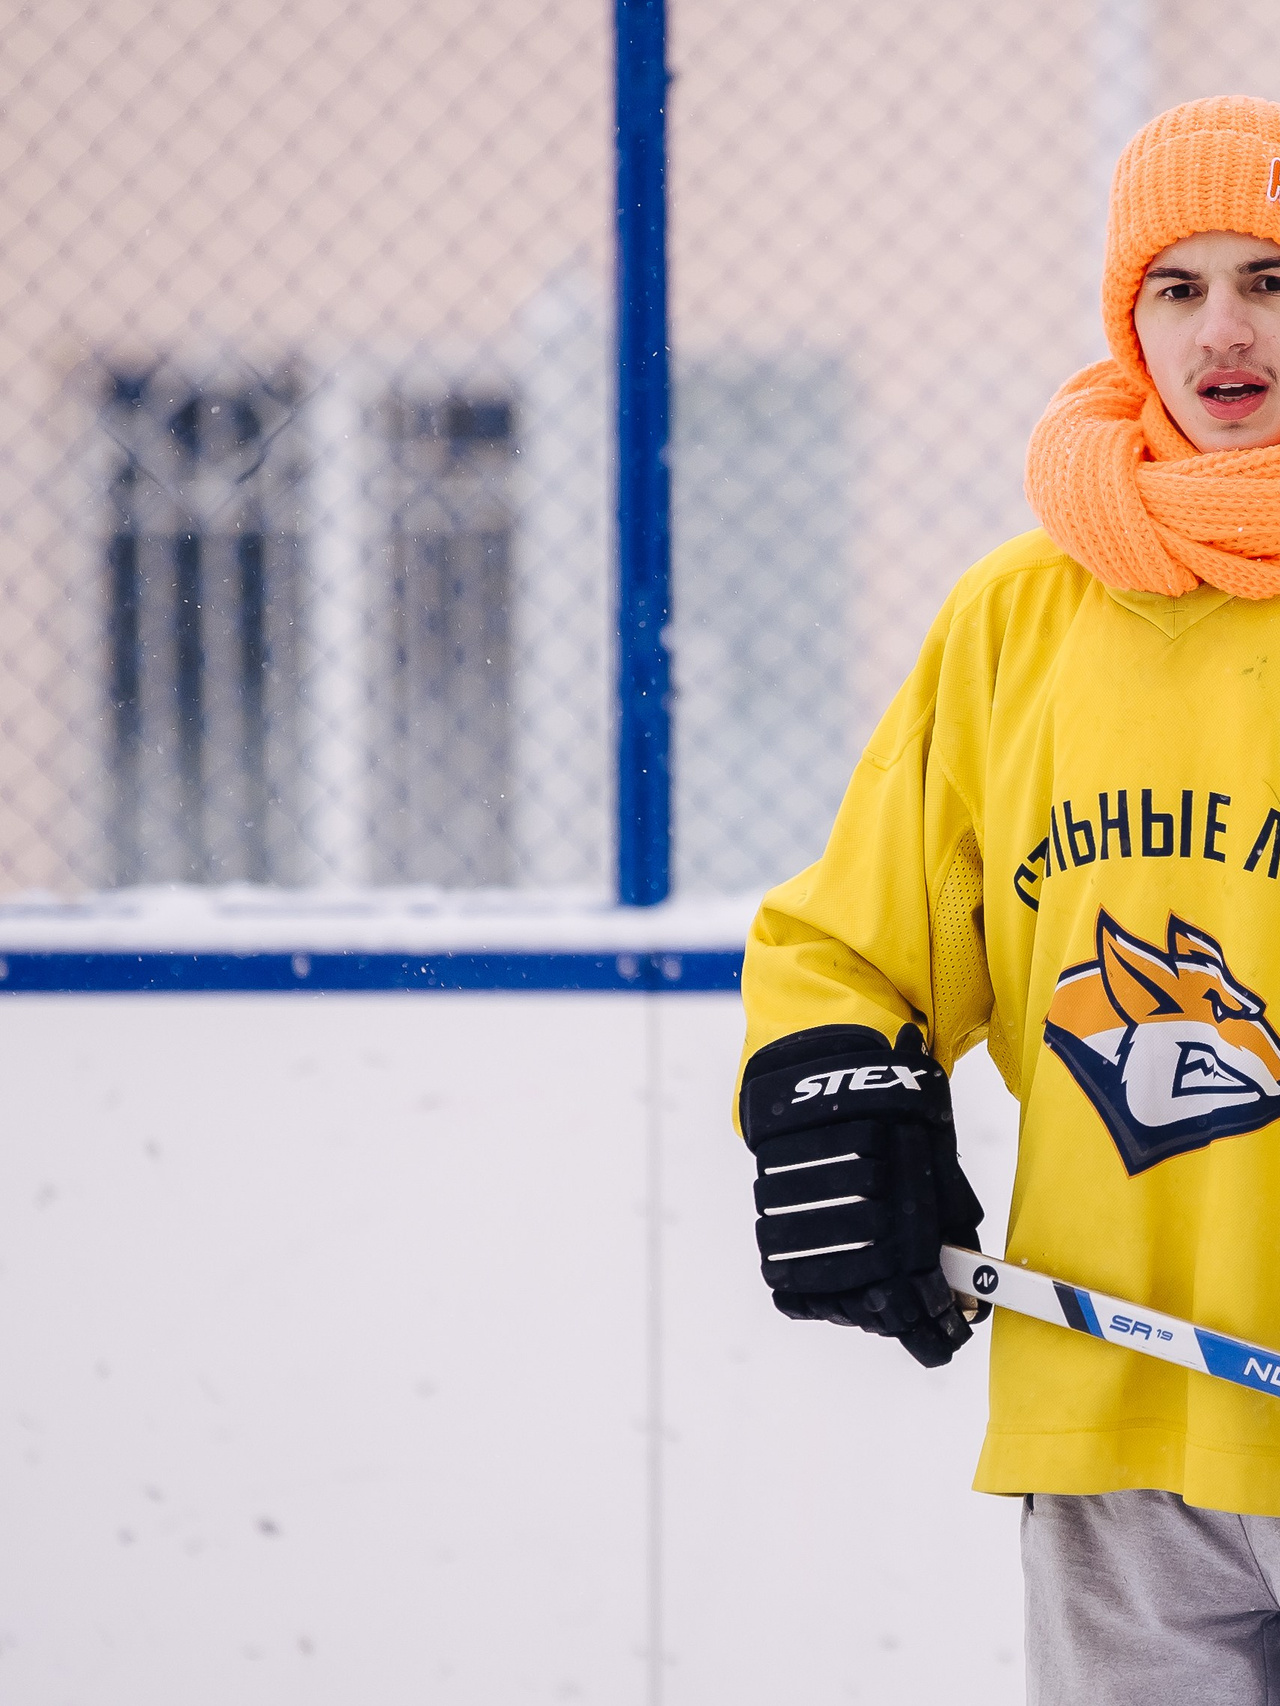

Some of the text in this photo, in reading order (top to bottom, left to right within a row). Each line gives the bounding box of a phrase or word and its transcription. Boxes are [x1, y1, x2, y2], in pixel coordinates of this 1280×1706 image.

[791, 1065, 928, 1104] STEX
[1109, 1314, 1174, 1341] SR 19
